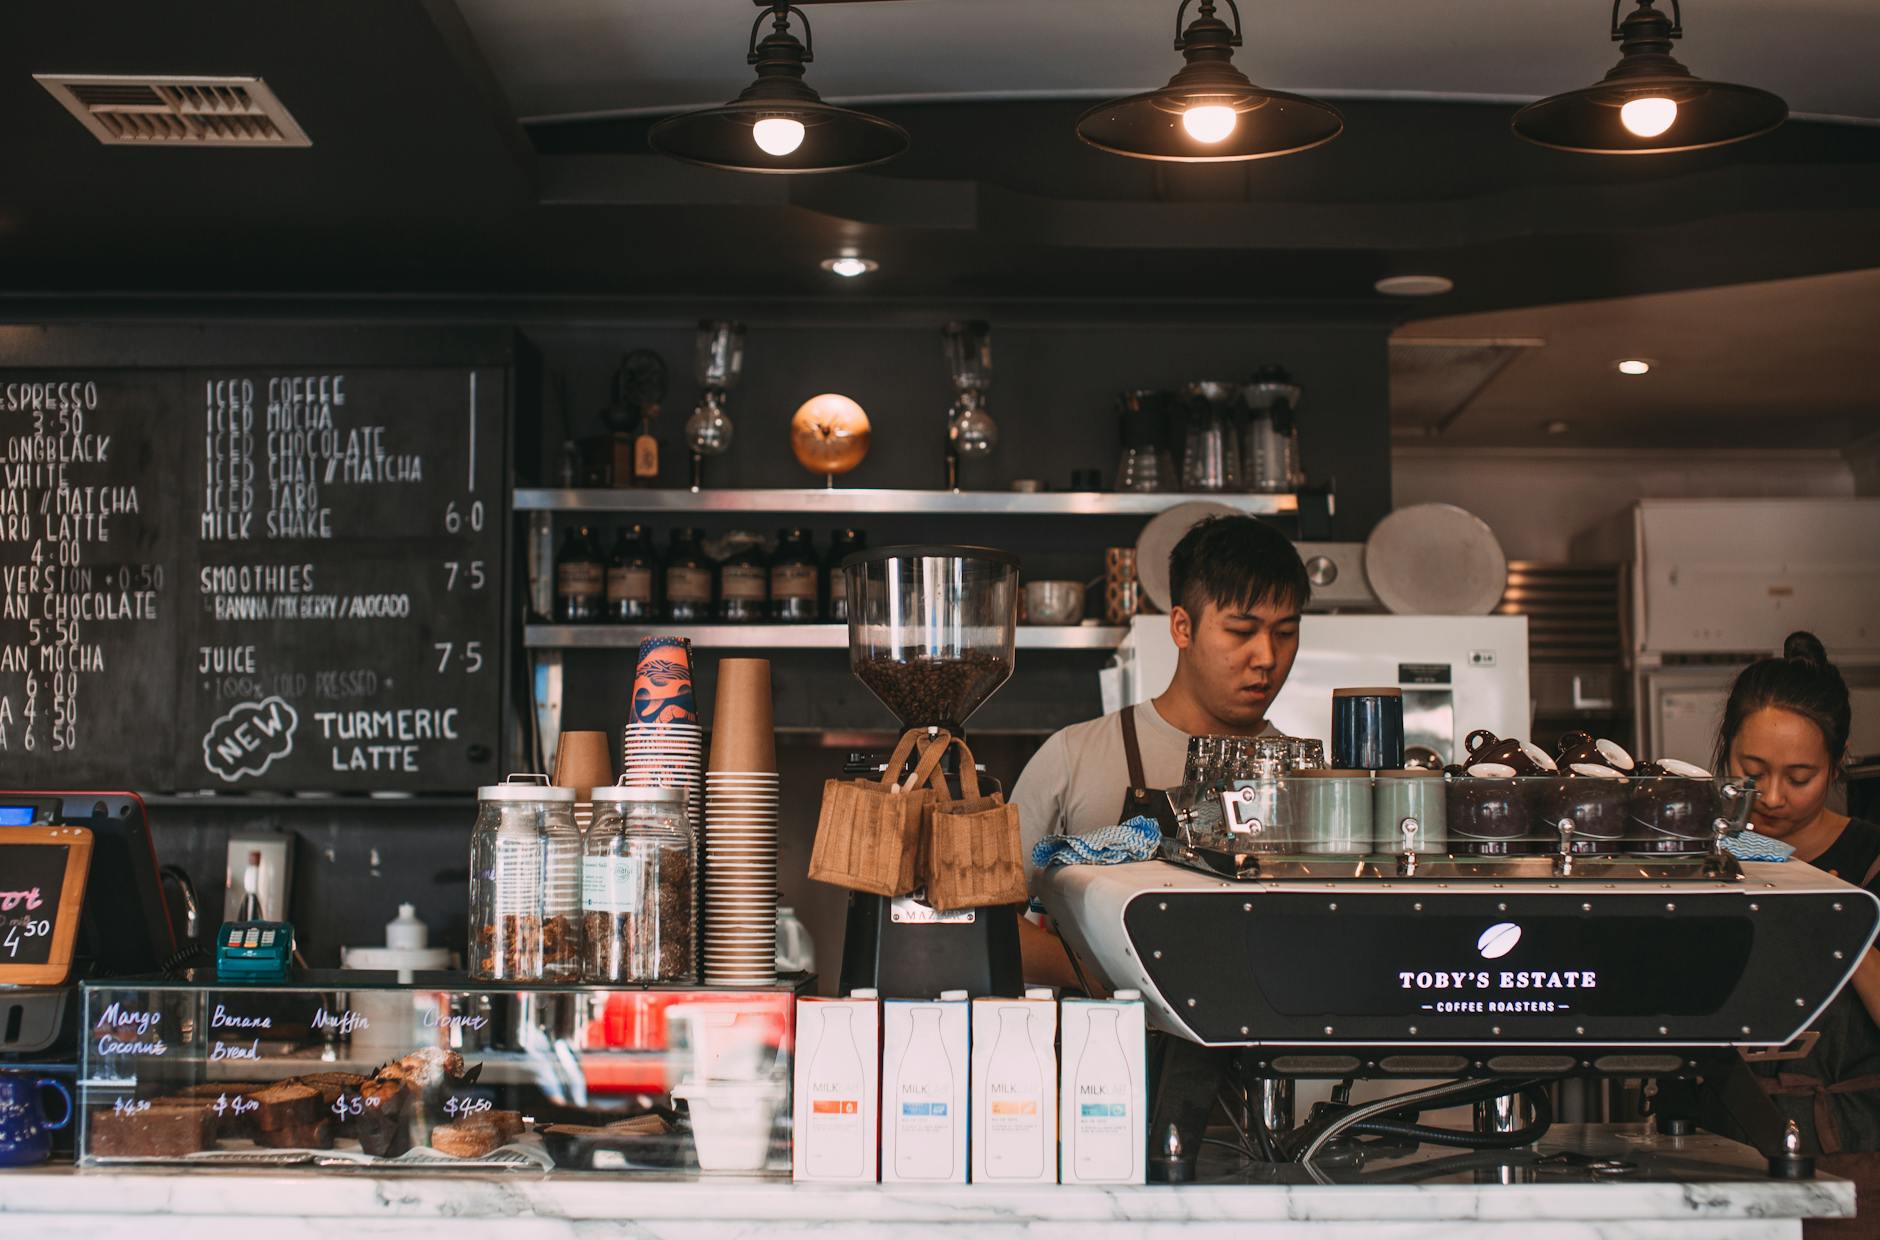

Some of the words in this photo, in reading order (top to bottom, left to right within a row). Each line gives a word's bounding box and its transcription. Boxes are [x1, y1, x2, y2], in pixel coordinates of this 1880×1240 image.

[206, 379, 254, 407] ICED
[269, 375, 345, 405] COFFEE
[206, 404, 254, 434] ICED
[267, 403, 333, 432] MOCHA
[206, 431, 255, 460] ICED
[268, 427, 385, 459] CHOCOLATE
[5, 463, 69, 489] WHITE
[206, 459, 255, 486] ICED
[206, 484, 255, 513] ICED
[47, 512, 109, 542] LATTE
[202, 512, 253, 540] MILK
[267, 508, 332, 538] SHAKE
[4, 565, 92, 594] VERSION
[200, 564, 315, 594] SMOOTHIES
[44, 590, 157, 621] CHOCOLATE
[40, 643, 104, 672] MOCHA
[199, 645, 256, 674] JUICE
[217, 704, 284, 763] NEW
[314, 708, 458, 740] TURMERIC
[332, 746, 418, 771] LATTE
[1399, 971, 1490, 988] TOBY'S
[1500, 971, 1596, 988] ESTATE
[97, 1002, 161, 1035] Mango
[211, 1005, 272, 1028] Banana
[310, 1007, 370, 1035] Muffin
[1436, 1001, 1484, 1013] COFFEE
[1488, 1001, 1555, 1012] ROASTERS
[98, 1034, 168, 1056] Coconut
[210, 1039, 261, 1061] Bread
